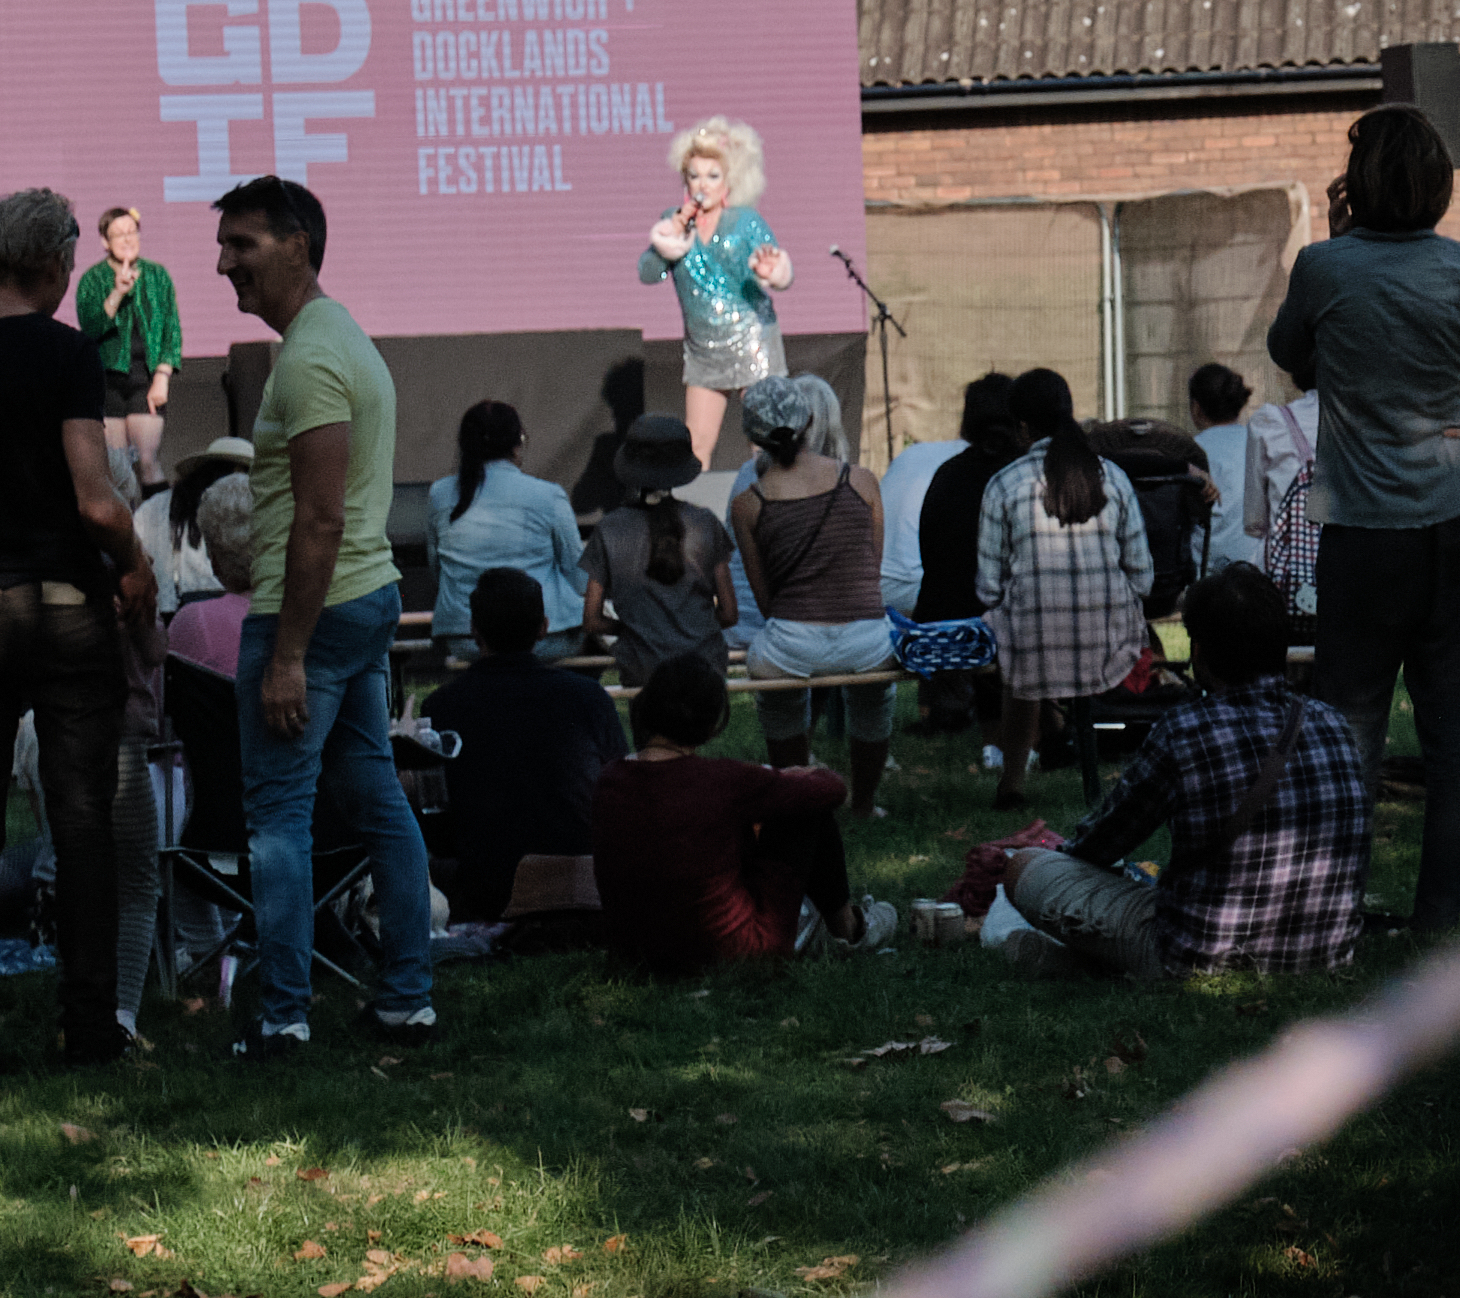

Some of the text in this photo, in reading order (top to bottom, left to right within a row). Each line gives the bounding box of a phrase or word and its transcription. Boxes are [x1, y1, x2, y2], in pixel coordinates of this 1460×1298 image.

[412, 28, 610, 81] DOCKLANDS
[415, 82, 674, 139] INTERNATIONAL
[418, 144, 573, 195] FESTIVAL
